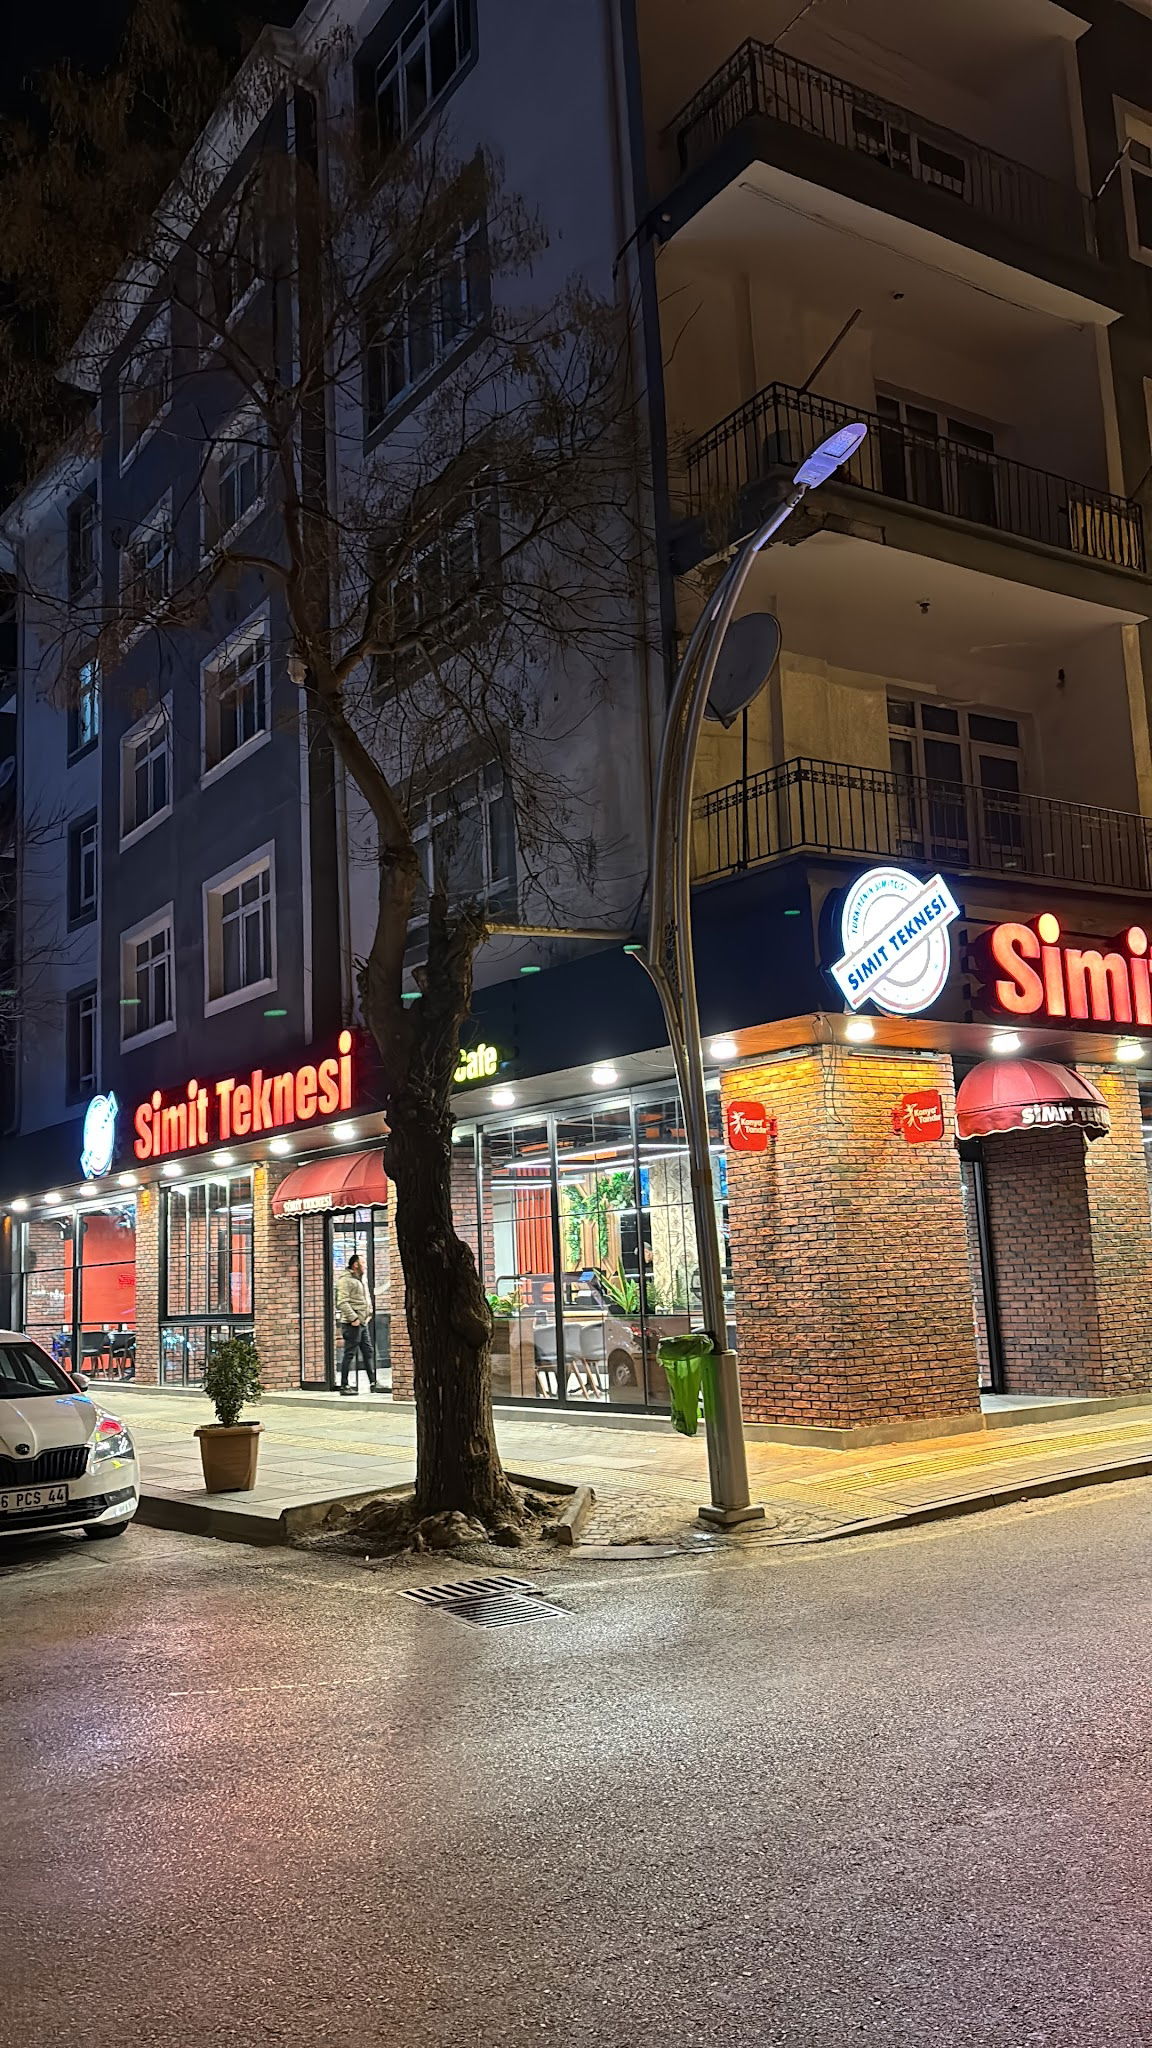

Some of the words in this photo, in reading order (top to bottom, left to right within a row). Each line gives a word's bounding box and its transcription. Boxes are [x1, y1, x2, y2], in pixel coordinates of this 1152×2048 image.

[992, 913, 1152, 1026] Simi
[134, 1079, 209, 1160] Simit
[216, 1030, 352, 1141] Teknesi
[16, 1491, 41, 1507] PCS
[49, 1488, 64, 1502] 44
